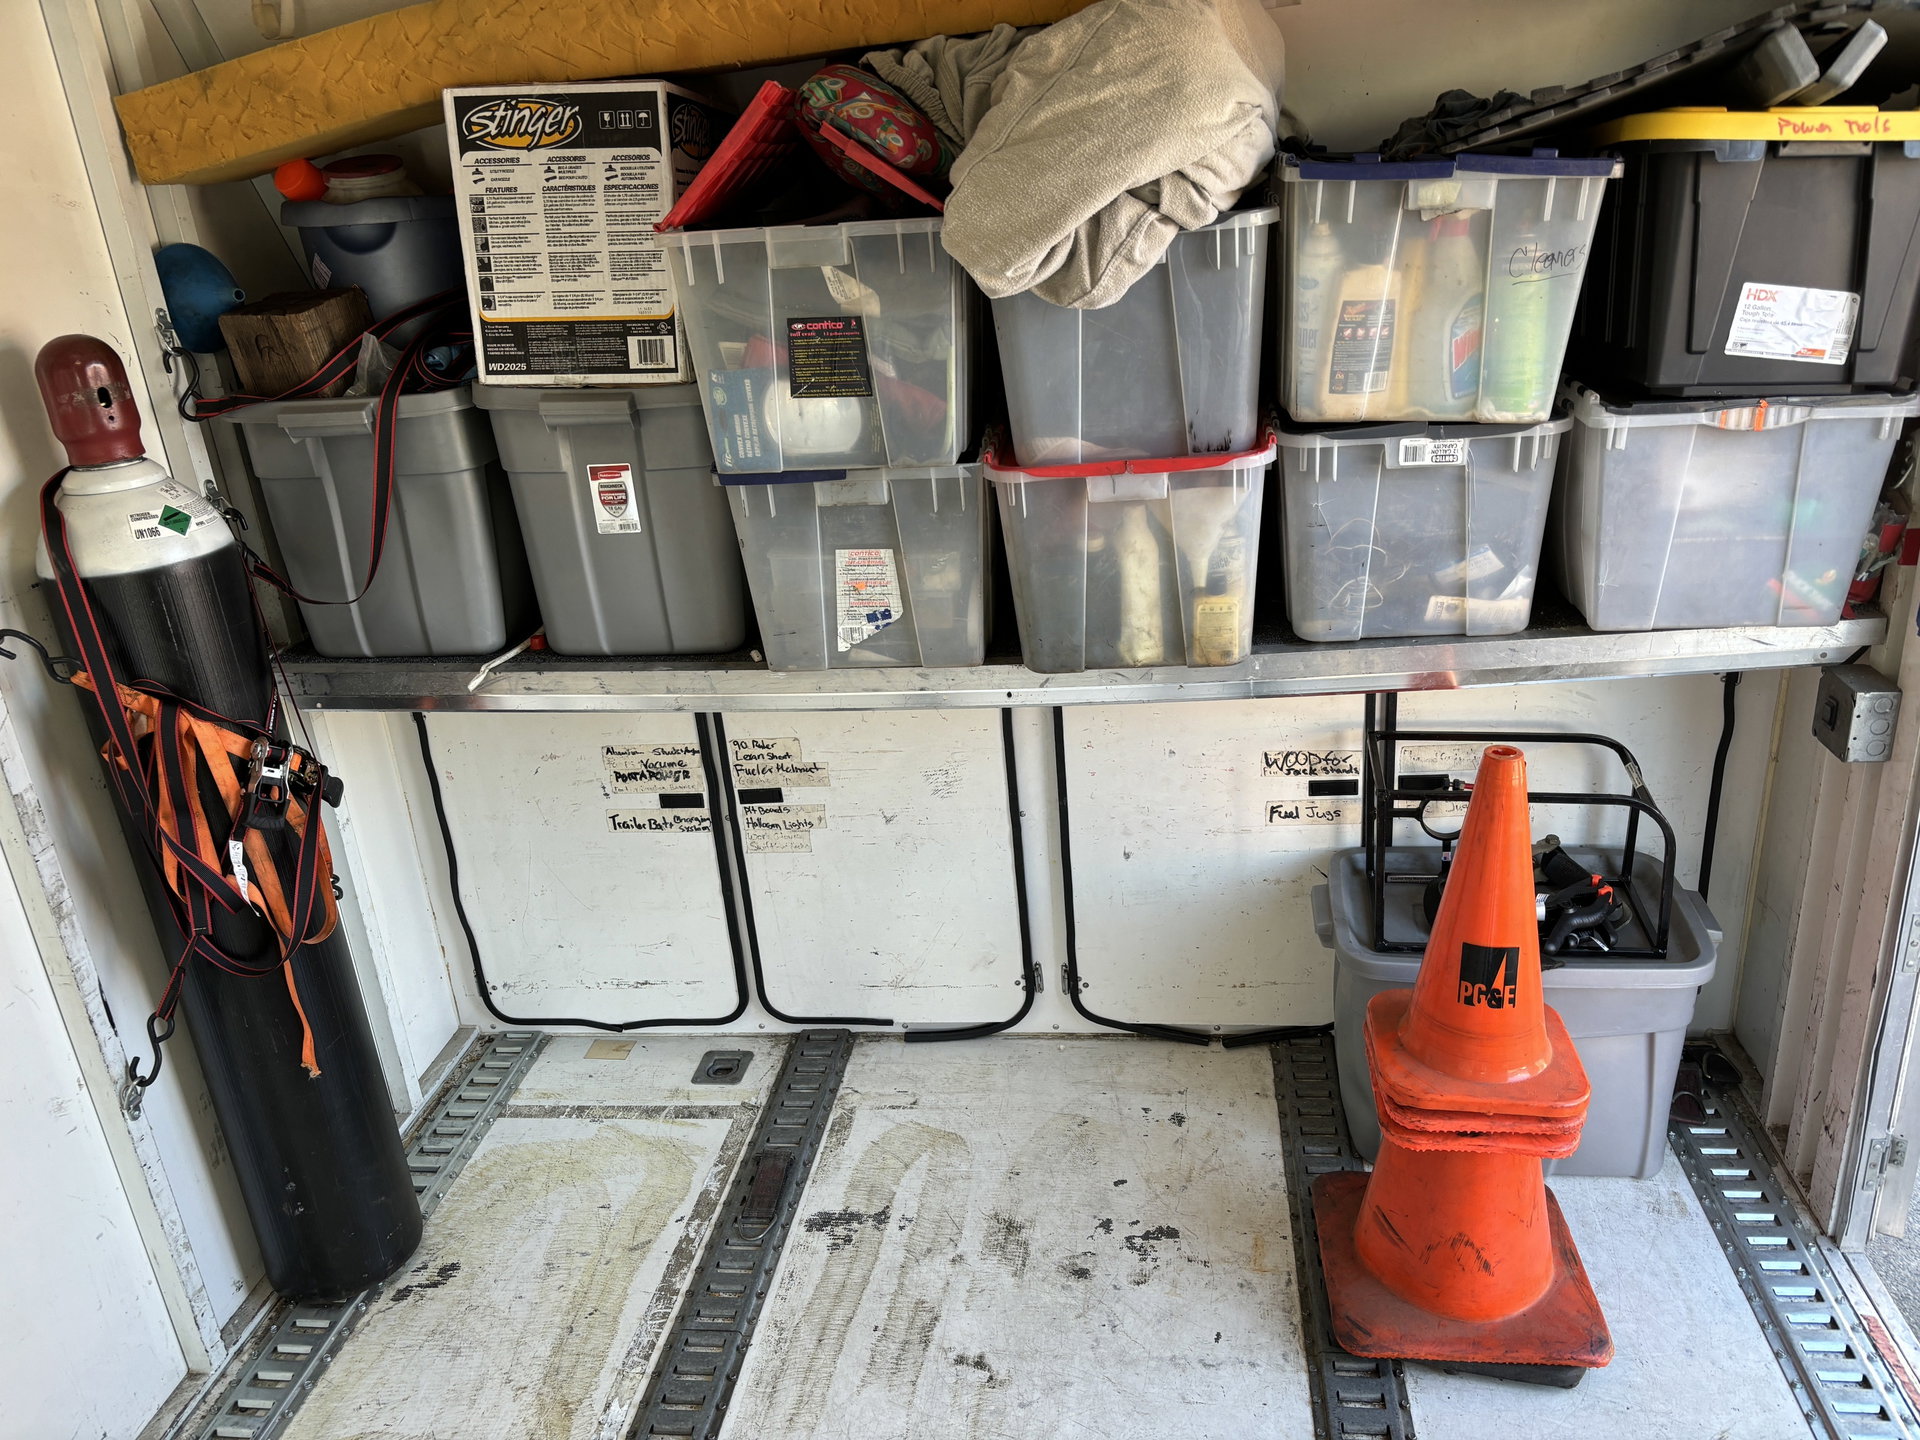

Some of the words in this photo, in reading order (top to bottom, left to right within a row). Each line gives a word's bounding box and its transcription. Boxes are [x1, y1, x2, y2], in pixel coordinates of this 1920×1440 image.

[466, 99, 579, 148] Stinger
[1778, 117, 1832, 135] Power
[1844, 115, 1890, 134] Tools
[603, 183, 659, 191] ESPECIFICACIONES
[1746, 288, 1778, 302] HDX
[806, 321, 843, 330] contico
[488, 362, 527, 371] WD2025
[134, 526, 161, 539] UN1066
[1285, 766, 1318, 776] Jack
[1269, 804, 1300, 823] Fuel
[1305, 806, 1341, 821] Jugs
[608, 814, 646, 830] Trailer
[782, 819, 814, 830] Lights
[1460, 981, 1515, 1009] PG&E
